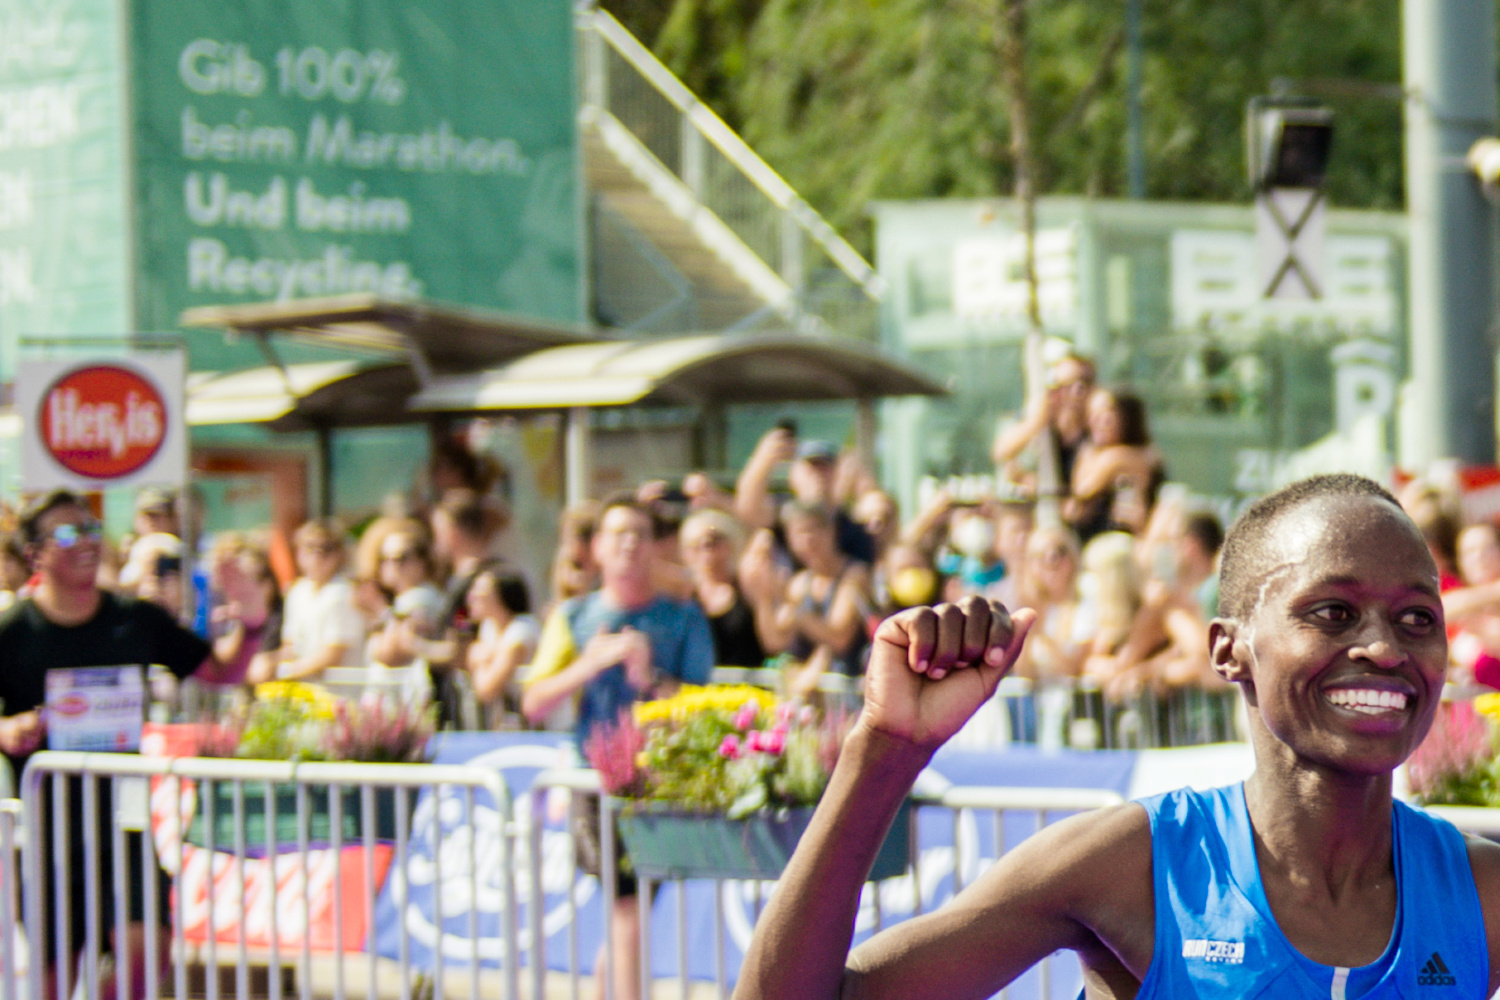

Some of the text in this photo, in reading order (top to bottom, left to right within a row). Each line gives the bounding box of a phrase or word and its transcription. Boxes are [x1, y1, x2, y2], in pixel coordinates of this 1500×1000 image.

[178, 38, 408, 105] Gib 100%
[181, 104, 531, 176] beim Marathon.
[185, 171, 411, 233] Und beim
[50, 388, 160, 460] Hervis
[1417, 973, 1456, 986] adidas
